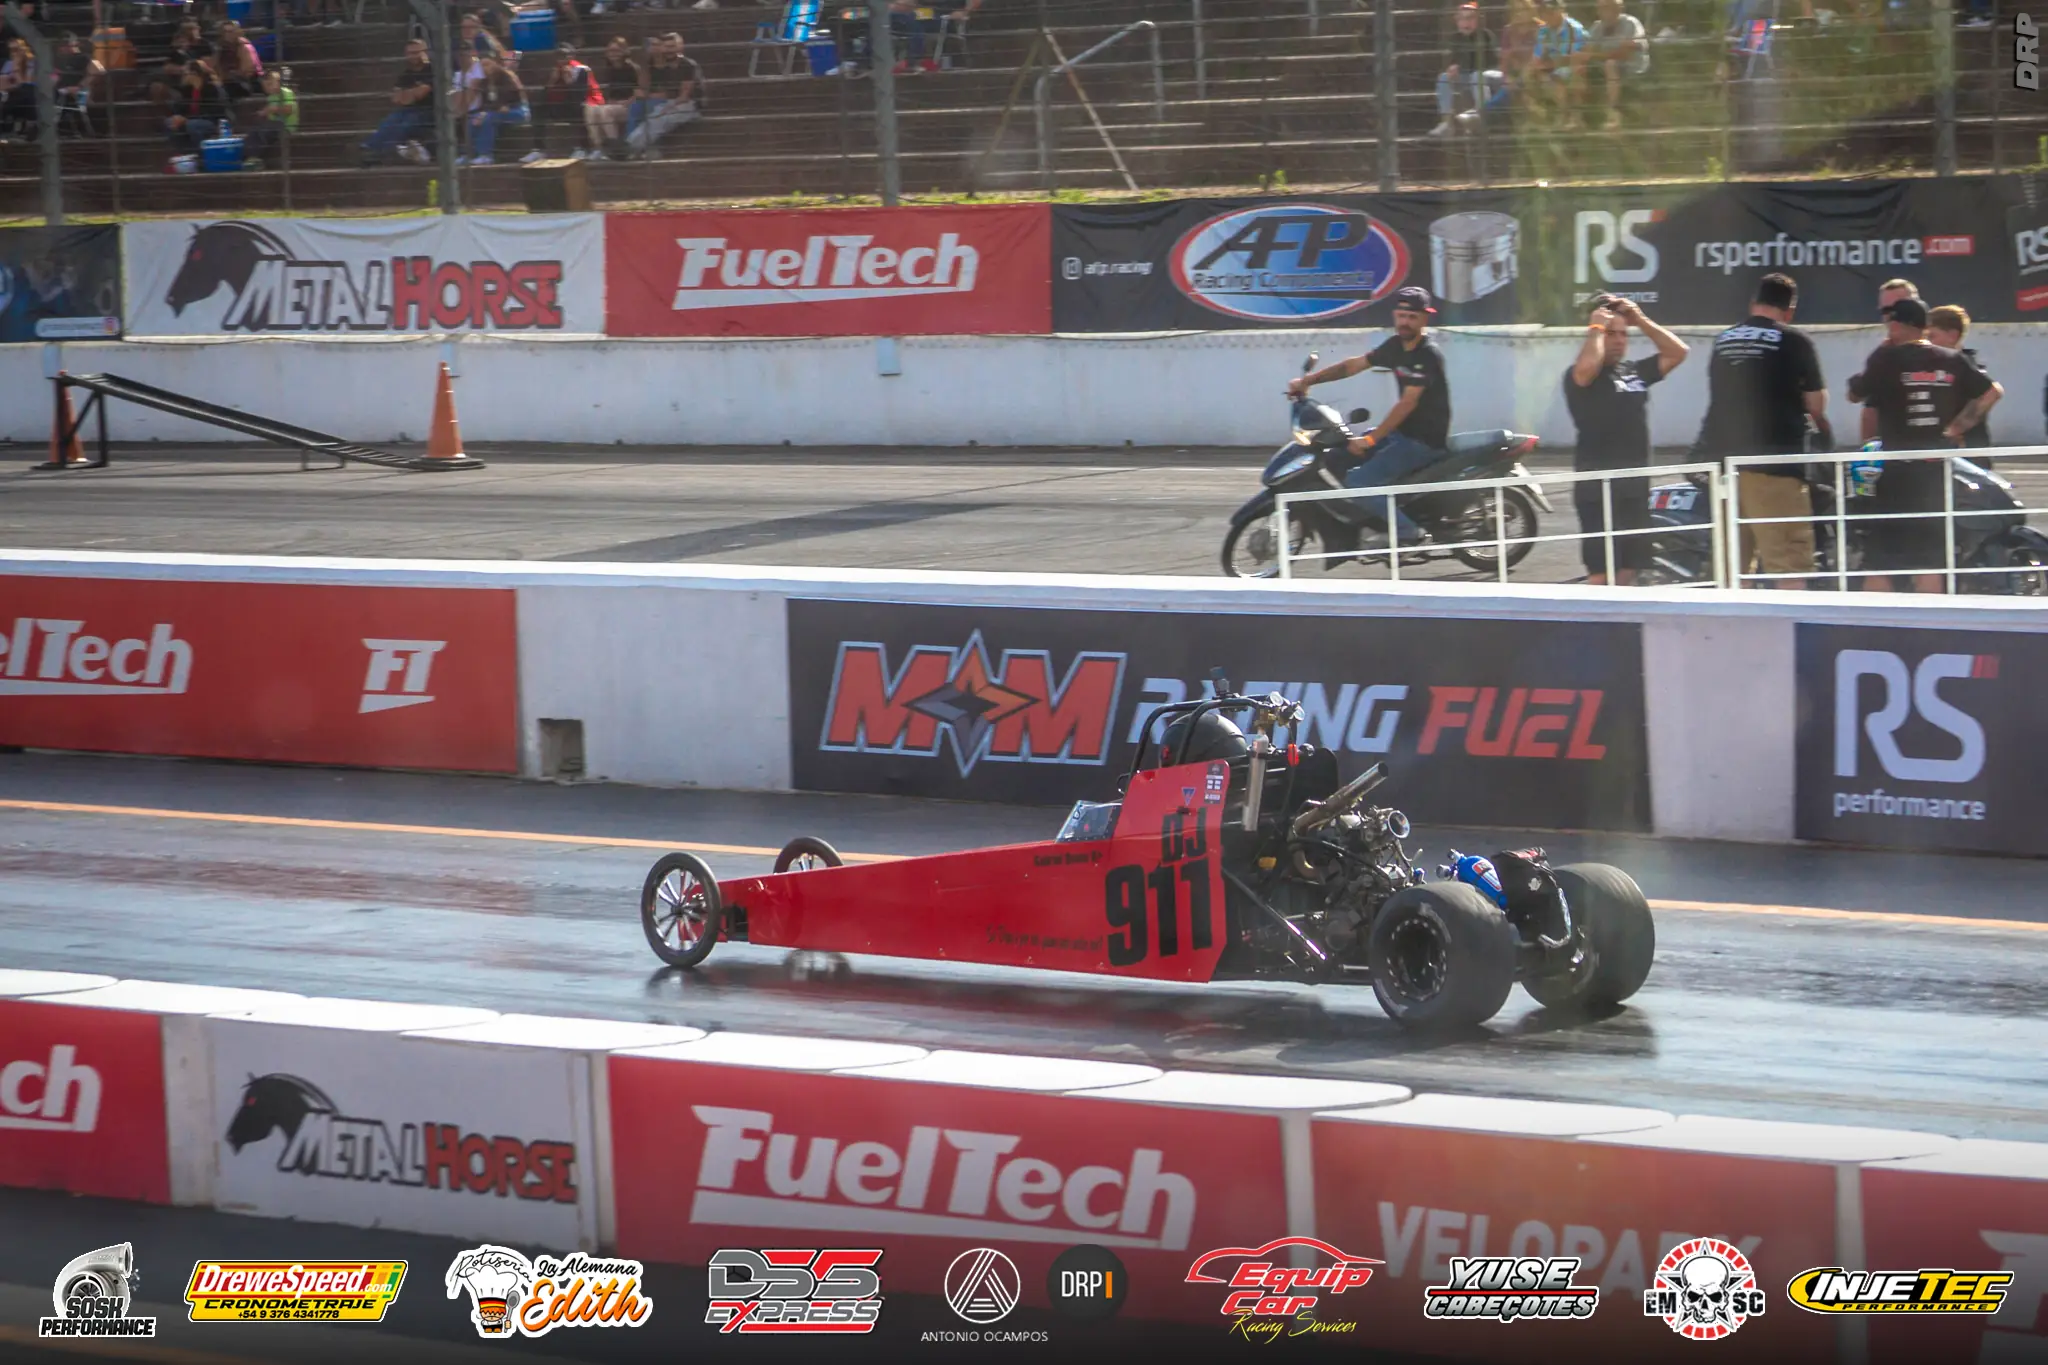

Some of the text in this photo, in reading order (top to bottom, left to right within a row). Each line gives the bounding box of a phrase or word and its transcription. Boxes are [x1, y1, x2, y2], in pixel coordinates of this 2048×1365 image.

[675, 233, 980, 292] FuelTech
[1574, 209, 1665, 284] RS
[1416, 685, 1608, 761] FUEL
[1834, 649, 1998, 783] RS
[1833, 788, 1987, 821] performance
[1105, 858, 1213, 967] 911
[690, 1105, 1198, 1252] FuelTech
